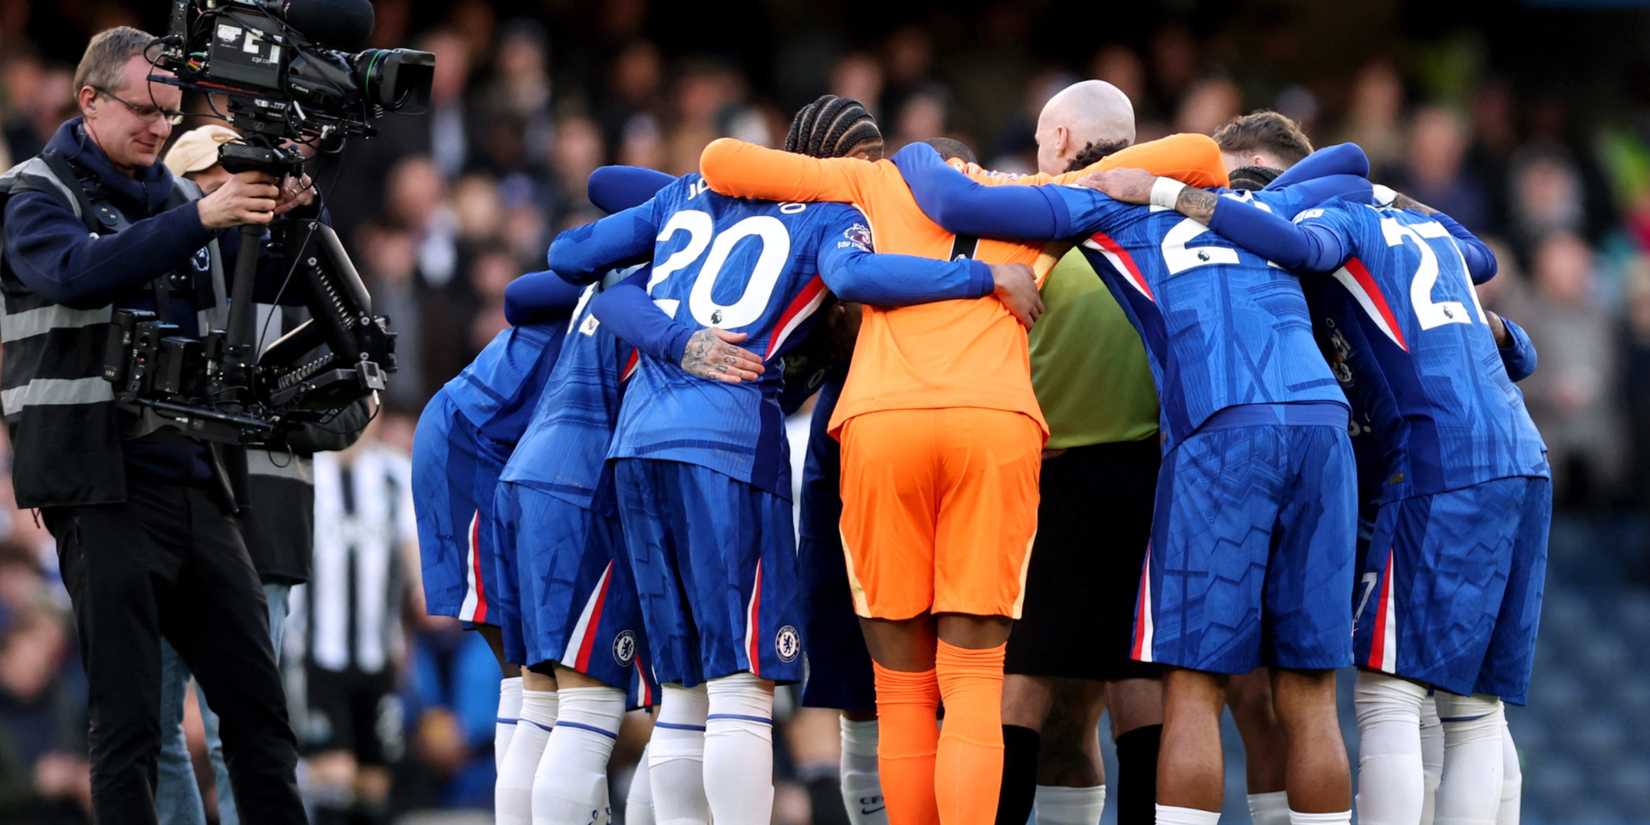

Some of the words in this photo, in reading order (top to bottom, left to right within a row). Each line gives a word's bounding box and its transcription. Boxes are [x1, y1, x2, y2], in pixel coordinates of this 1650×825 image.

[688, 178, 709, 200] JO
[647, 210, 790, 329] 20
[1380, 217, 1488, 330] 27
